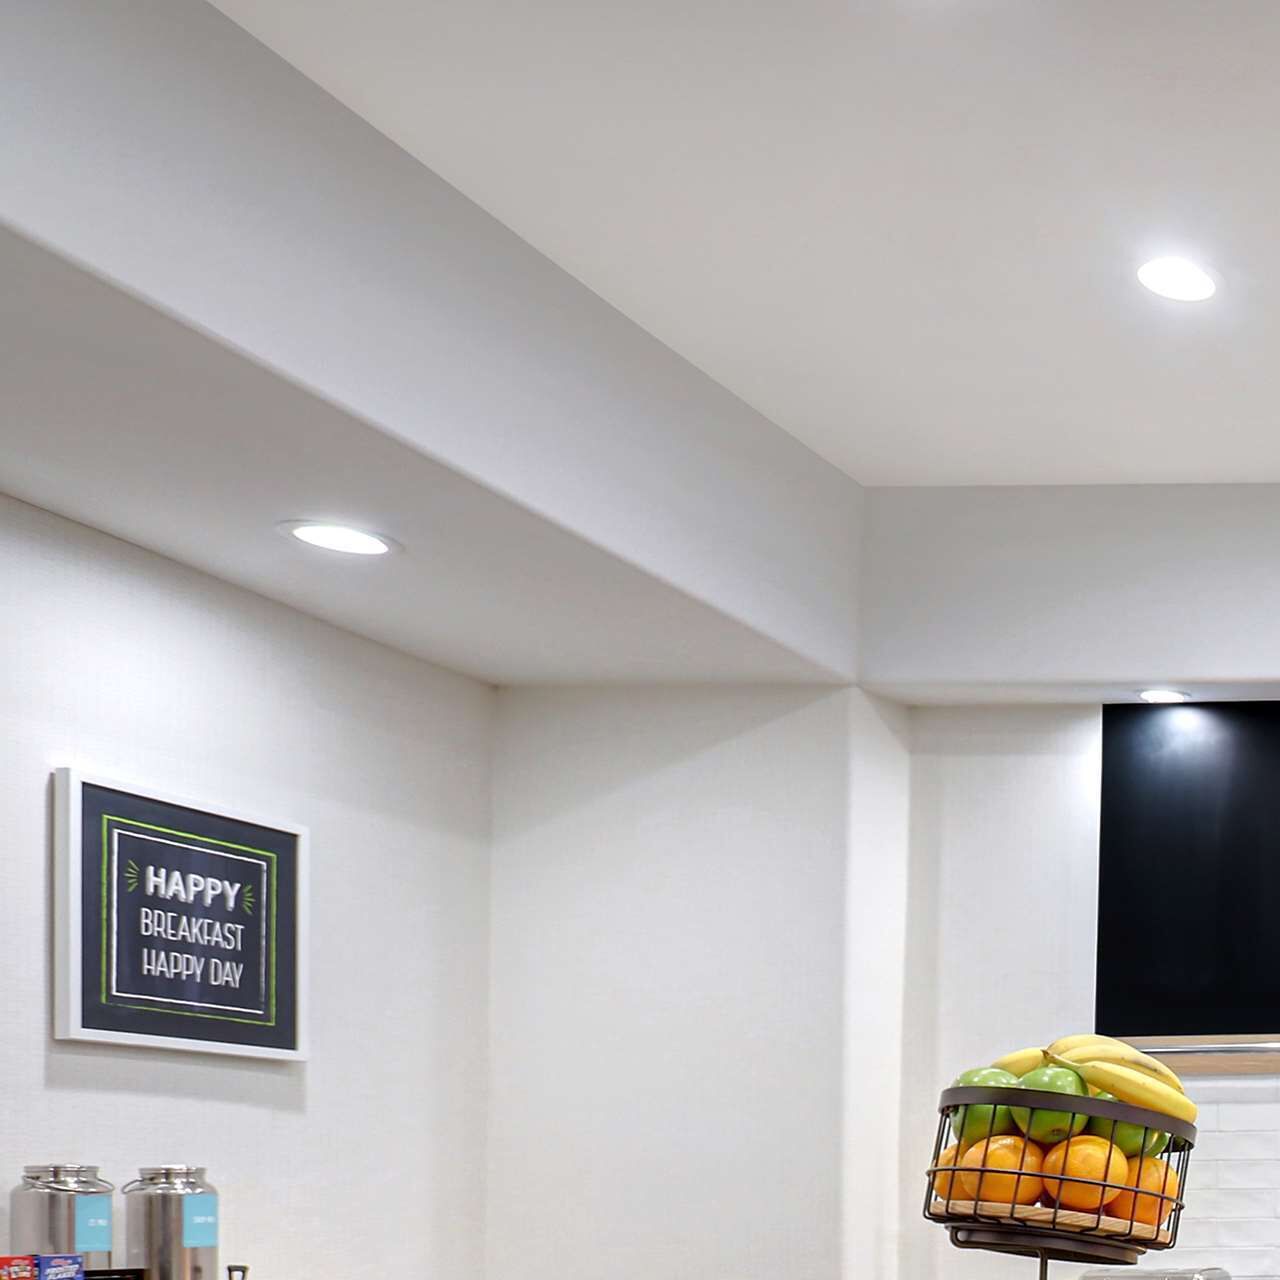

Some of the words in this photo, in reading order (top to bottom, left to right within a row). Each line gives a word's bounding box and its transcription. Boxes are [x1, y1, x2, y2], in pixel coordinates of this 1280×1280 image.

[145, 864, 241, 912] HAPPY
[139, 907, 245, 952] BREAKFAST
[142, 947, 205, 983] HAPPY
[209, 957, 244, 989] DAY
